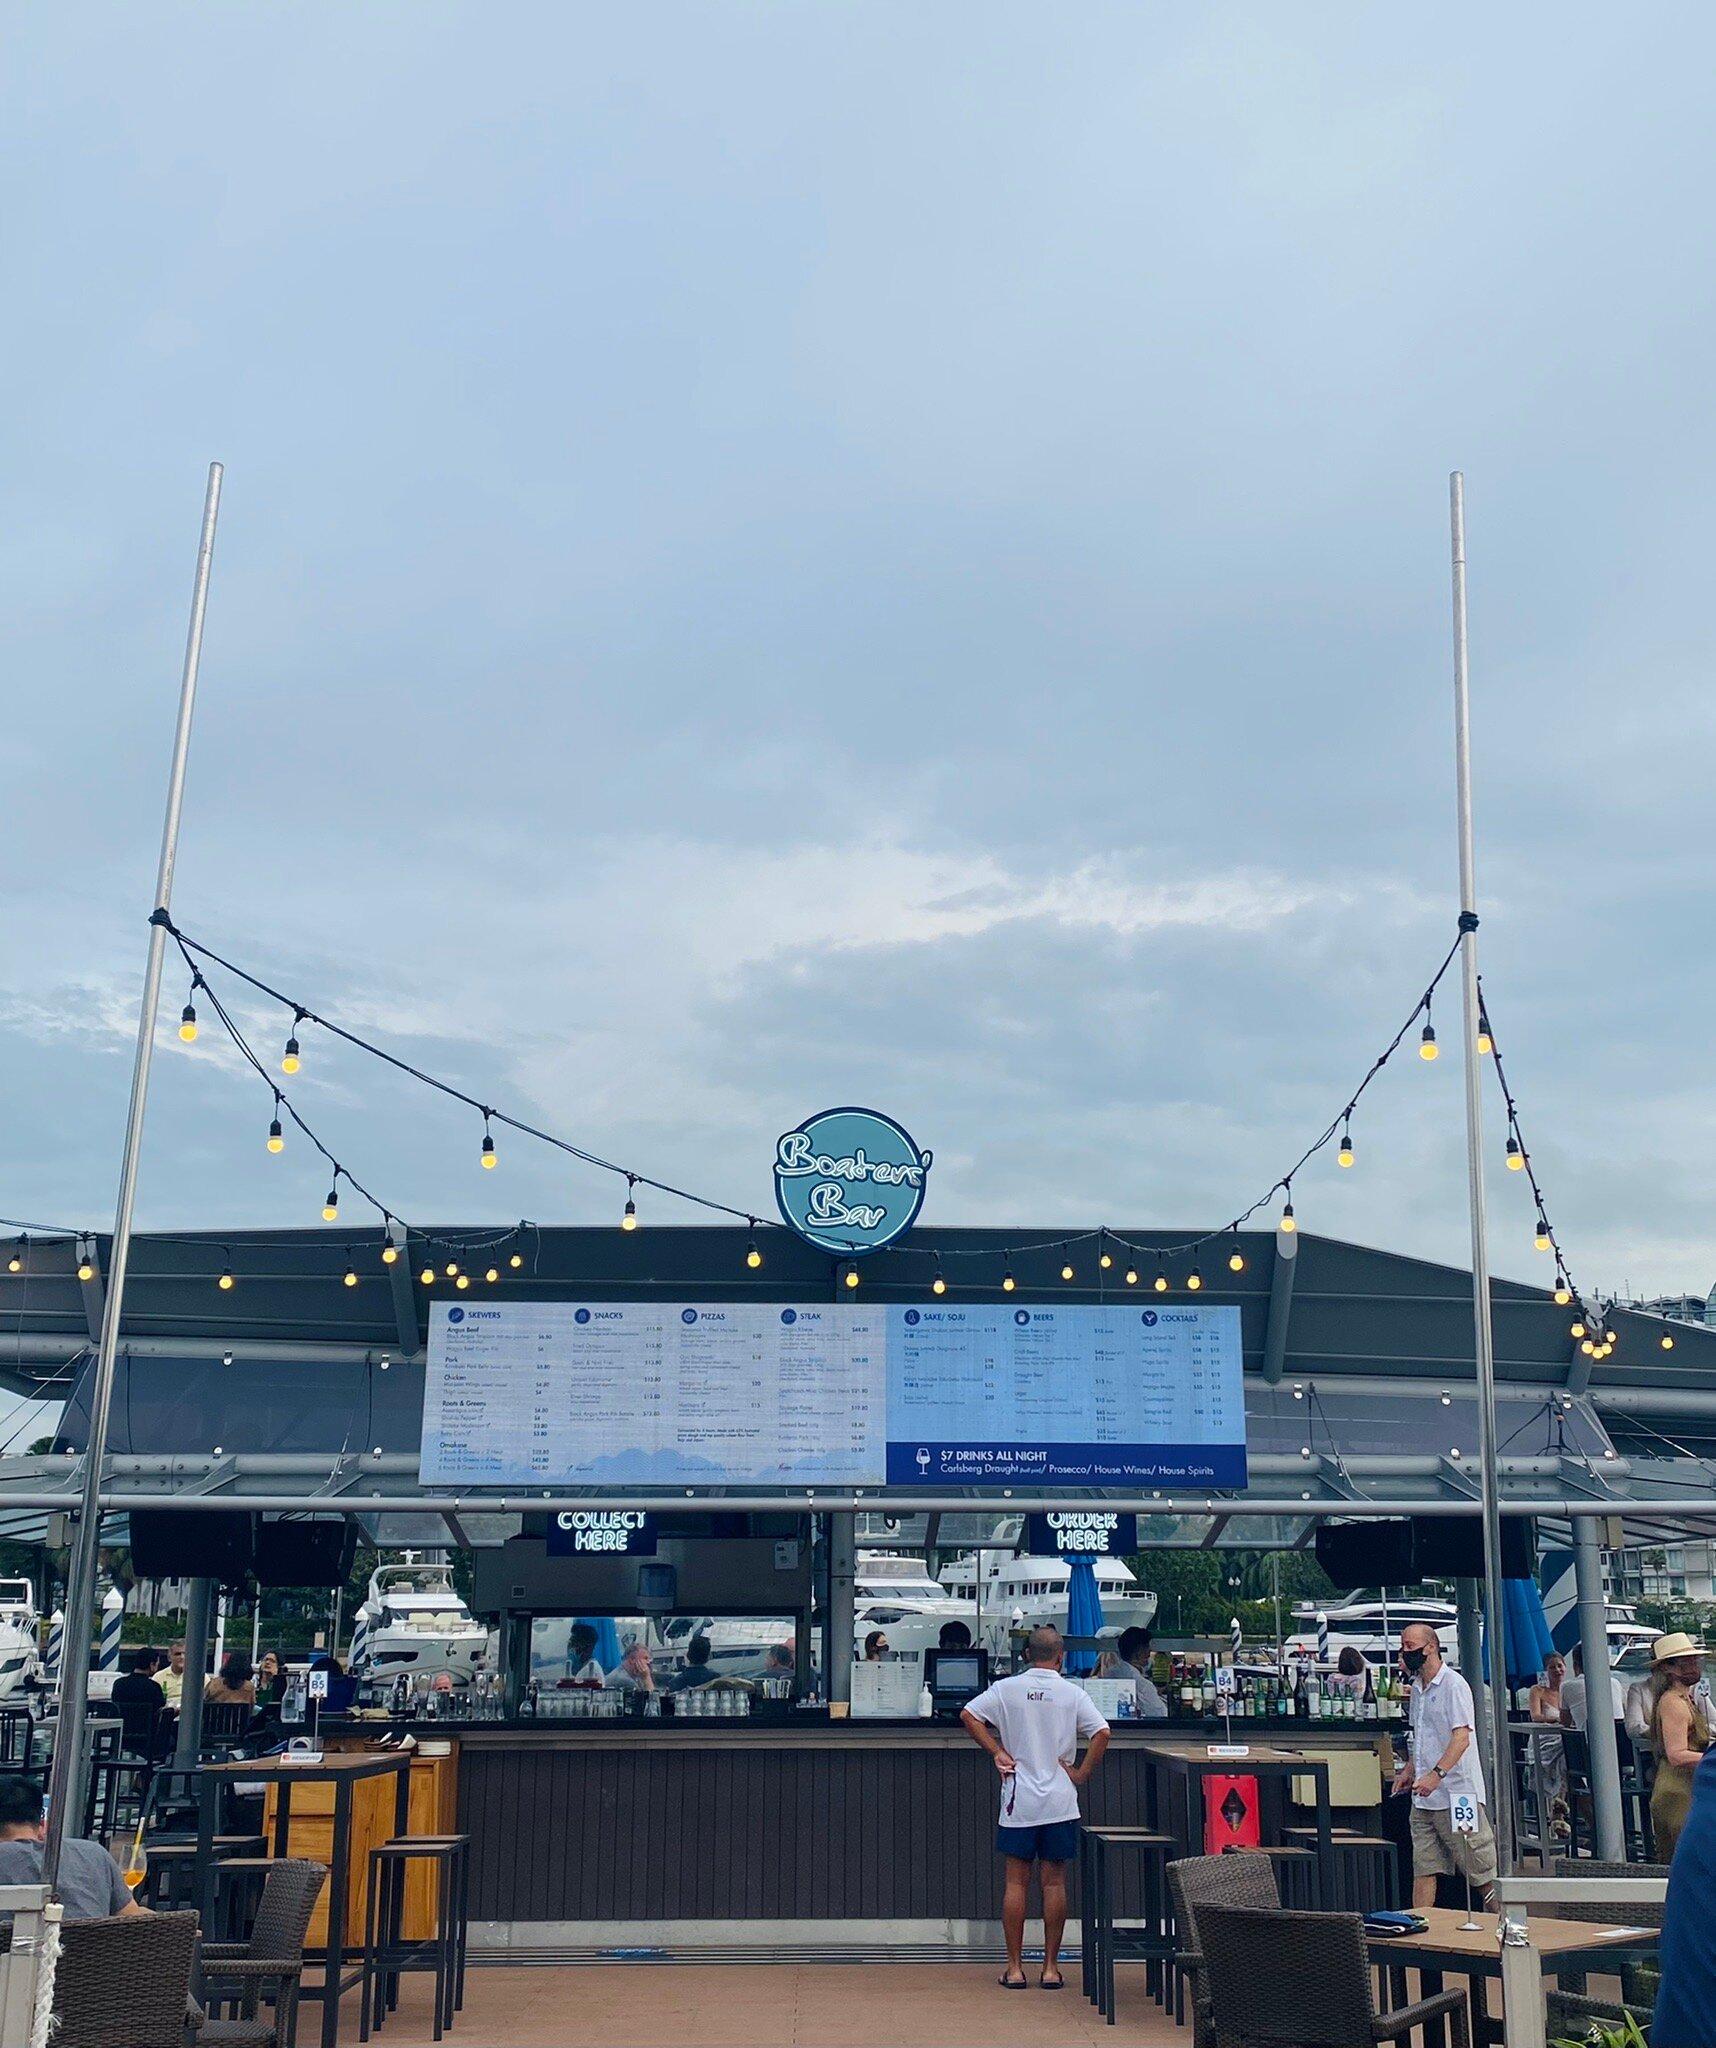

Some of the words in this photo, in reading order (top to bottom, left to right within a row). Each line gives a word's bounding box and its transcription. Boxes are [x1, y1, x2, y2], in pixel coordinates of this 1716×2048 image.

[807, 1182, 886, 1229] Bar
[468, 1311, 501, 1319] SKEWERS
[594, 1312, 623, 1320] SNACKS
[1033, 1313, 1054, 1321] BEERS
[1161, 1314, 1198, 1322] COCKTAILS
[941, 1450, 952, 1462] $7
[956, 1451, 994, 1461] DRINKS
[996, 1451, 1013, 1461] ALL
[1015, 1451, 1047, 1461] NIGHT
[941, 1463, 982, 1475] Carlsberg
[985, 1464, 1019, 1475] Draught
[1094, 1464, 1121, 1474] House
[1158, 1465, 1186, 1475] House
[1188, 1465, 1214, 1477] Spirits
[557, 1511, 646, 1530] COLLECT
[575, 1530, 628, 1551] HERE
[1056, 1529, 1109, 1551] HERE
[311, 1680, 325, 1690] B5
[1218, 1676, 1232, 1686] B4
[1454, 1806, 1474, 1820] B3
